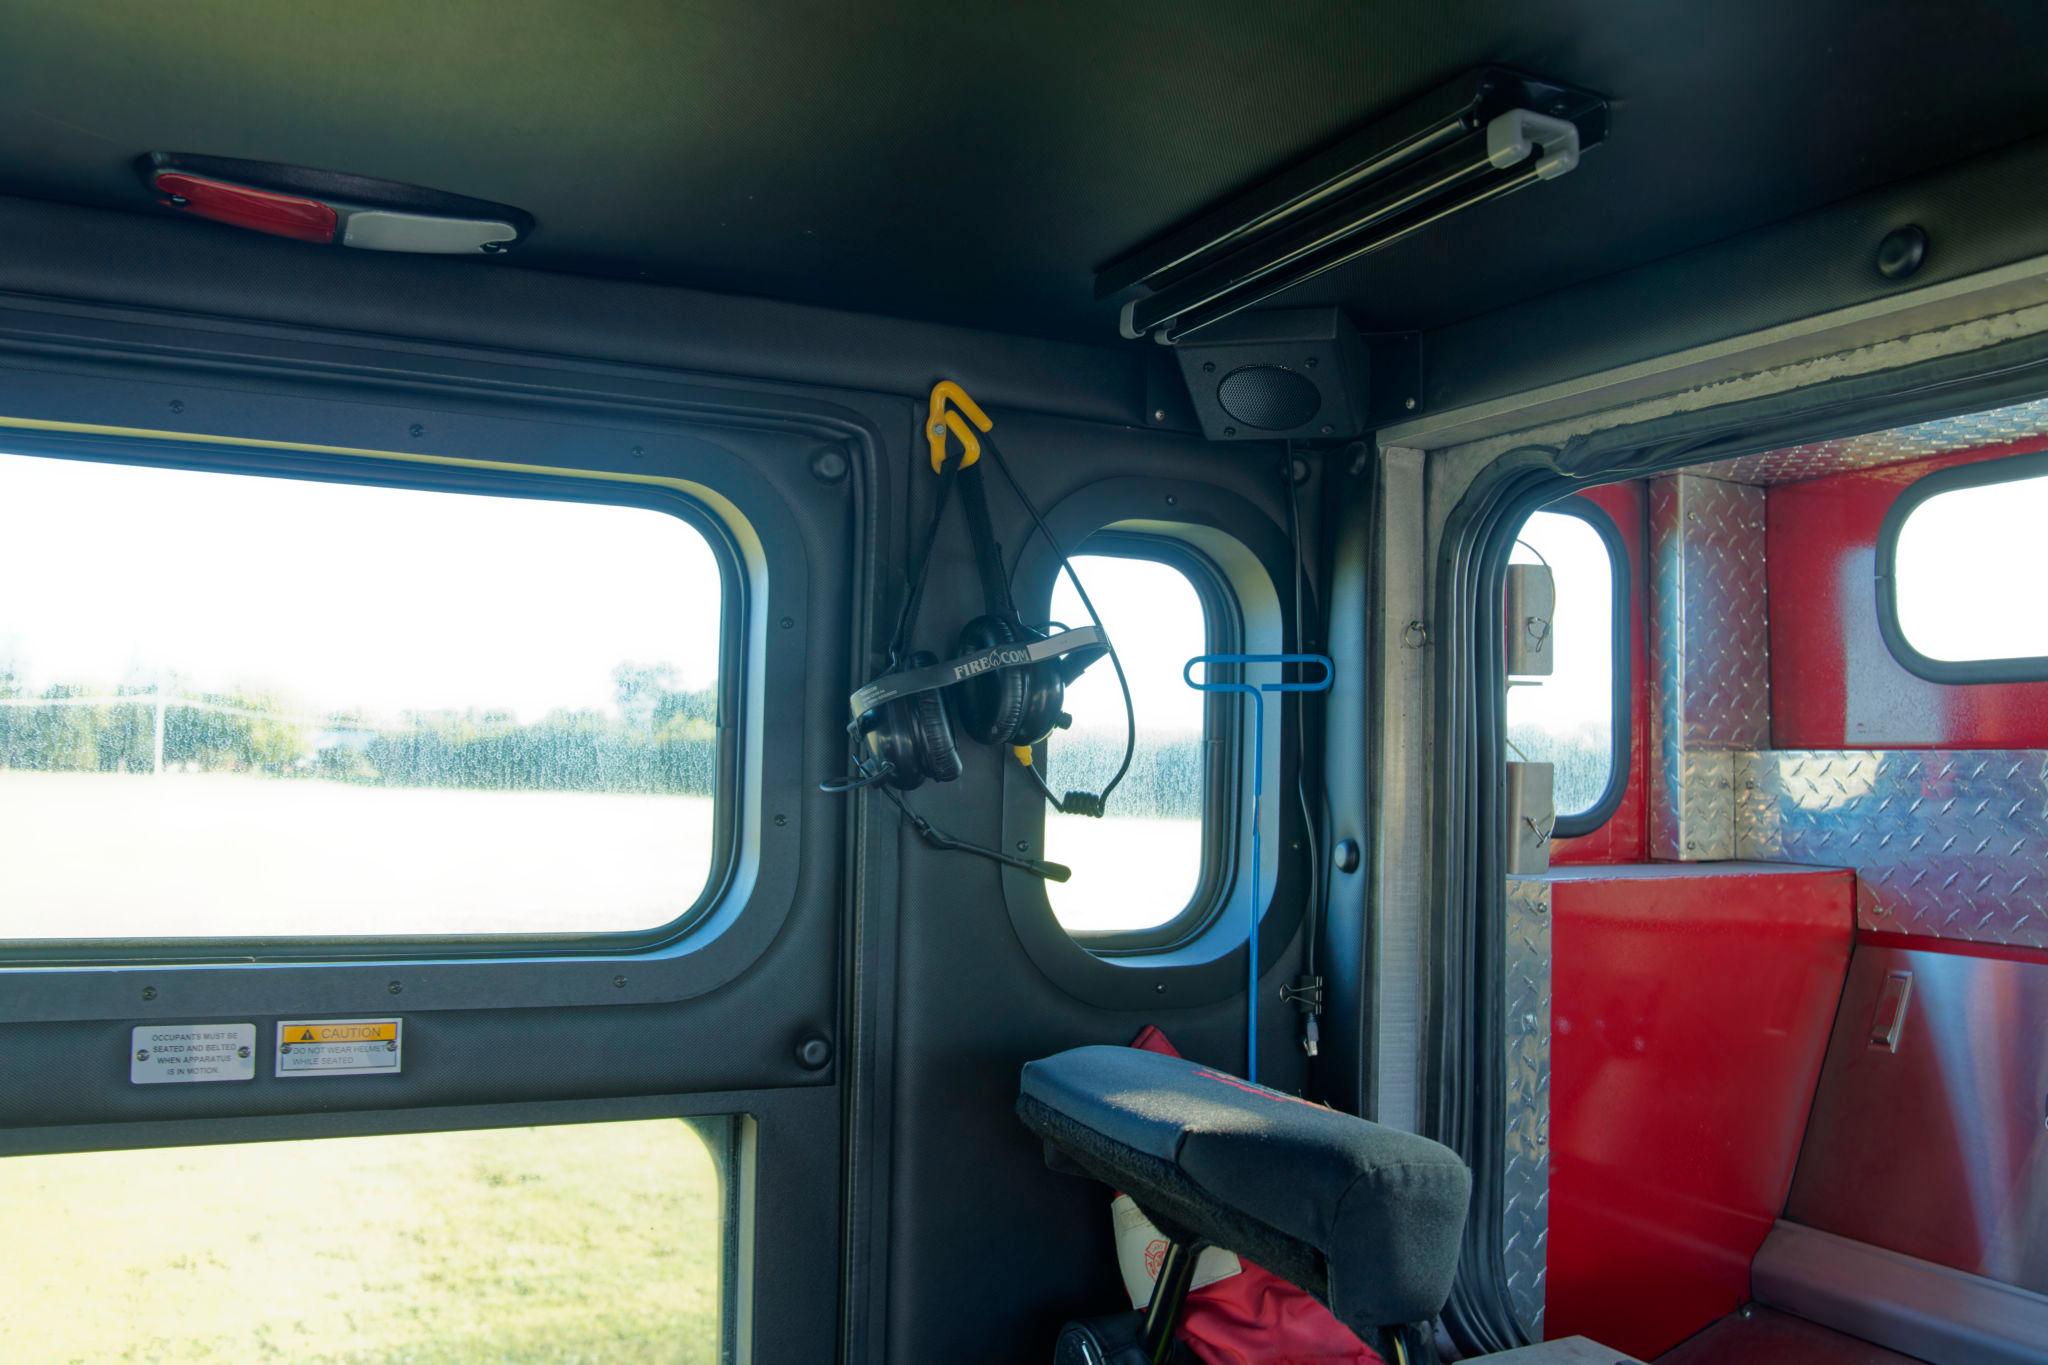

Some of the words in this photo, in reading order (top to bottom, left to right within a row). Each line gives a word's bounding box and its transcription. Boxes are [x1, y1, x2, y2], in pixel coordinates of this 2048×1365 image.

[203, 1032, 225, 1040] MUST
[321, 1028, 380, 1038] CAUTION
[152, 1045, 184, 1053] SEATED
[293, 1047, 305, 1055] DO
[308, 1046, 325, 1054] NOT
[327, 1046, 351, 1054] WEAR
[353, 1045, 386, 1053] HELMET
[157, 1056, 181, 1064] WHEN
[183, 1055, 232, 1064] APPARATUS
[293, 1057, 318, 1065] WHILE
[321, 1056, 354, 1065] SEATED
